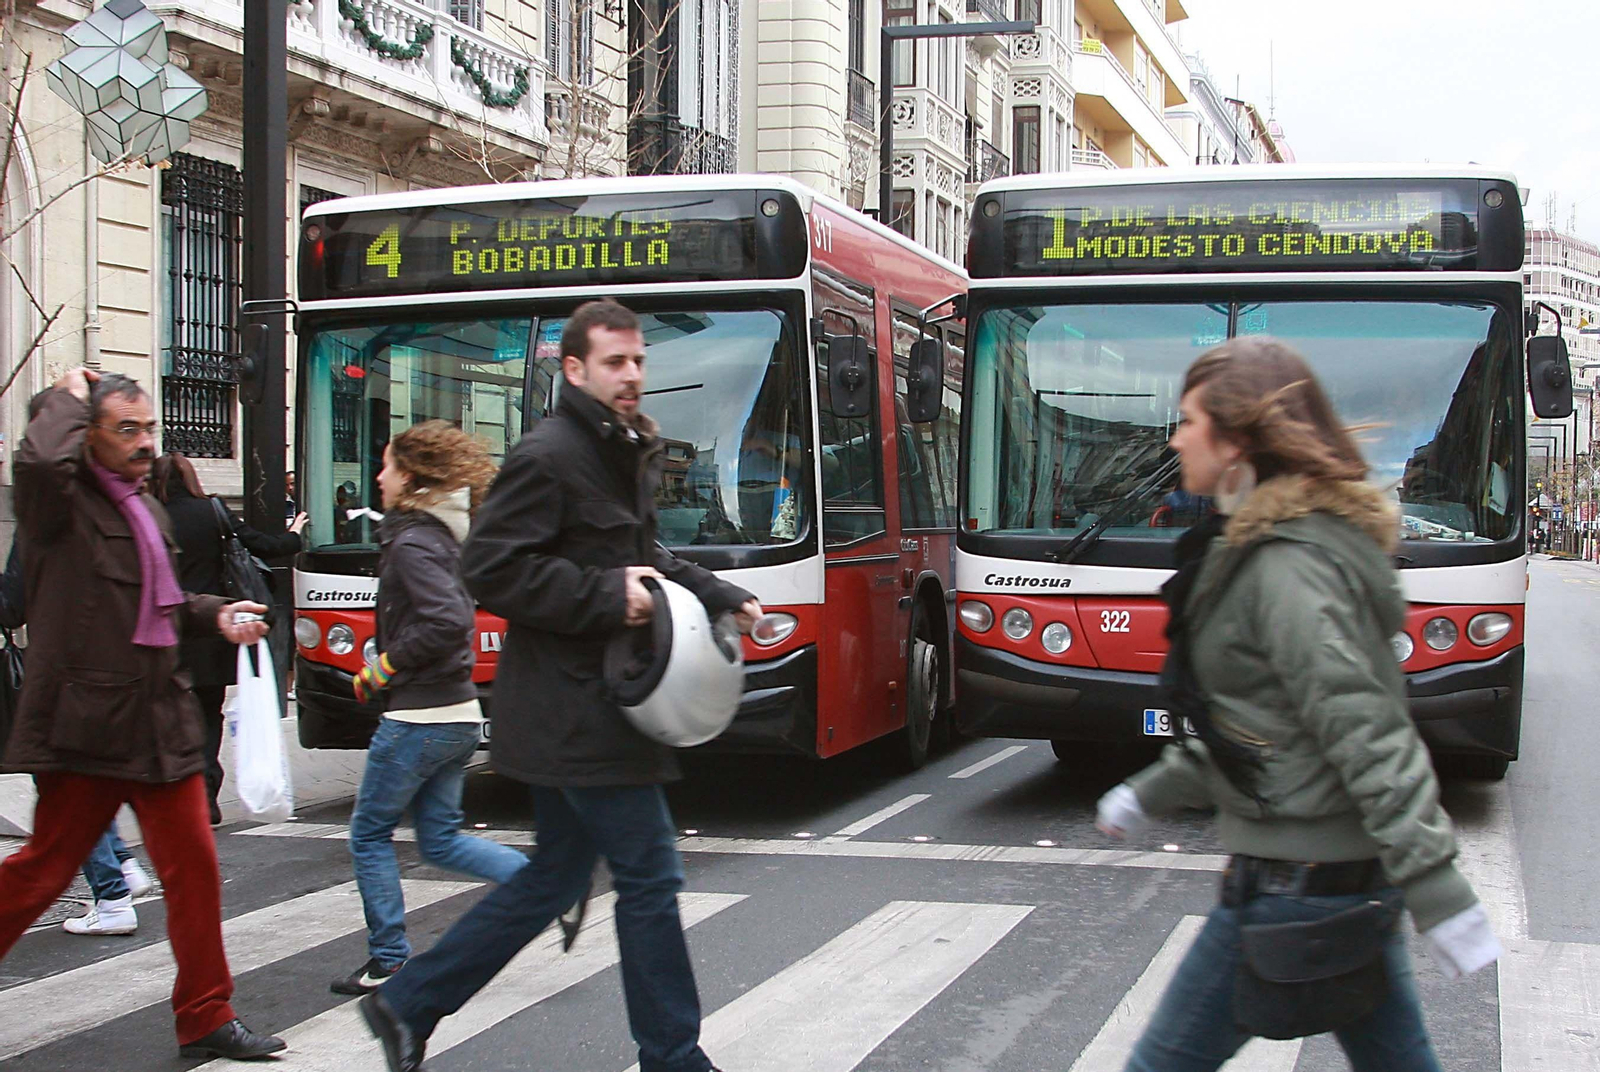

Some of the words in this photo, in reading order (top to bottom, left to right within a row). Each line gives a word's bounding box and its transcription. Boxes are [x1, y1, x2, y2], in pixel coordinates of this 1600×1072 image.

[450, 220, 477, 245] P.
[498, 211, 673, 242] DEPORTES
[1167, 203, 1235, 226] LAS
[1249, 199, 1434, 225] CIENCIAS
[813, 213, 832, 253] 317
[1043, 203, 1074, 259] 1
[1076, 234, 1246, 259] MODESTO
[366, 222, 401, 278] 4
[453, 239, 669, 275] BOBADILLA
[984, 573, 1072, 589] Castrosua
[1100, 610, 1131, 633] 322
